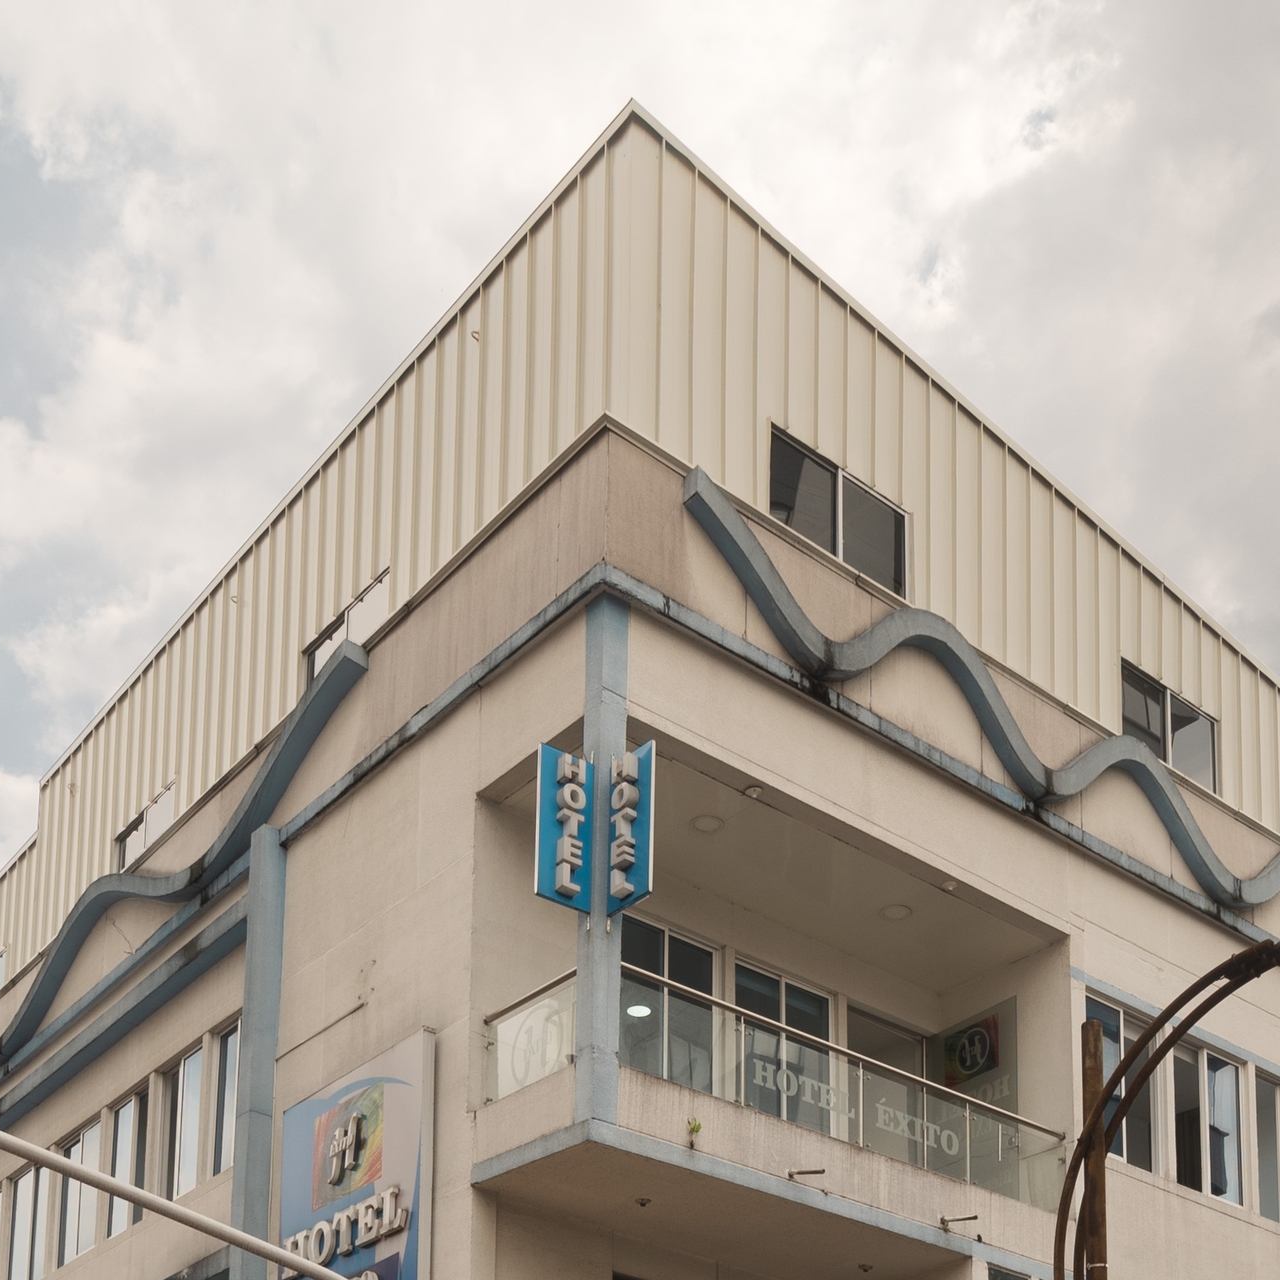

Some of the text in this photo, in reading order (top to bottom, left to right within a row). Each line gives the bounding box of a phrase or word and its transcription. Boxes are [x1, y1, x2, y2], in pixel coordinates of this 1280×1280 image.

[555, 752, 586, 897] HOTEL
[610, 751, 640, 899] HOTEL
[753, 1058, 856, 1120] HOTEL
[875, 1097, 960, 1156] ÉXITO
[282, 1187, 408, 1280] HOTEL
